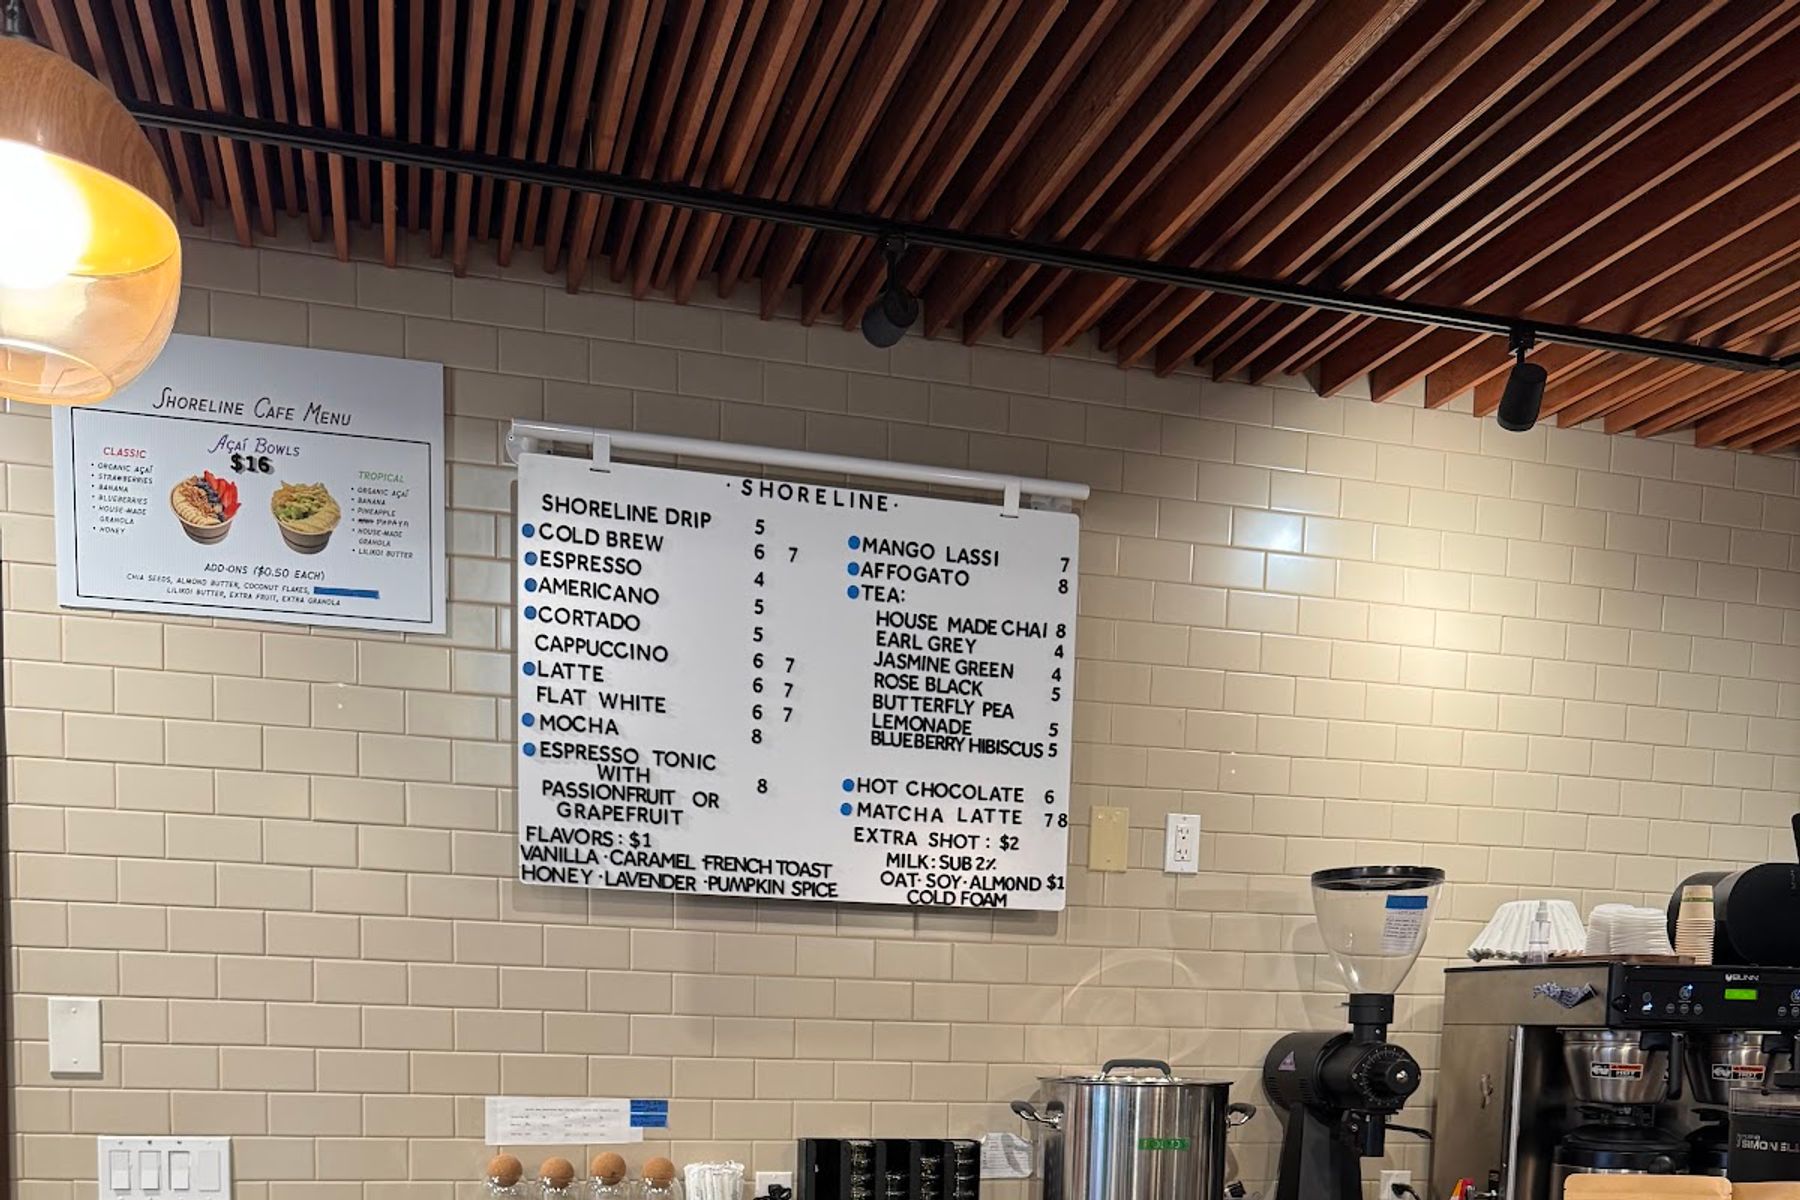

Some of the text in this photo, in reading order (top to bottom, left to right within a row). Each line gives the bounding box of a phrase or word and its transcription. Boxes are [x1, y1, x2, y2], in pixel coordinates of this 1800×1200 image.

[103, 447, 146, 458] CLASSIC
[231, 453, 272, 473] $16
[98, 462, 130, 471] ORGANIC
[98, 473, 152, 484] STRAWBERRIES
[359, 471, 404, 482] TROPICAL
[99, 484, 128, 492] BANANA
[99, 495, 148, 505] BLUEBERRIES
[357, 487, 388, 496] ORGANIC
[358, 497, 385, 505] BANANA
[740, 478, 888, 513] SHORELINE
[100, 516, 134, 524] GRANOLA
[357, 507, 395, 517] PINEAPPLE
[541, 493, 765, 536] SHORELINE DRIP 5
[359, 538, 391, 547] GRANOLA
[386, 550, 413, 558] BUTTER
[538, 522, 799, 563] COLD BREW 6 7
[862, 536, 1071, 573] MANGO LASSI 7
[204, 563, 248, 574] ADD-ONS
[295, 570, 326, 581] EACH)
[540, 549, 765, 588] ESPRESSO 4
[860, 561, 1069, 595] AFFOGATO 8
[177, 578, 207, 586] ALMOND
[243, 582, 278, 591] COCONUT
[538, 576, 765, 615] AMERICANO 5
[860, 583, 906, 604] TEA:
[229, 591, 253, 599] EXTRA
[282, 595, 304, 603] EXTRA
[308, 597, 341, 606] GRANOLA
[538, 605, 764, 643] CORTADO 5
[875, 609, 1067, 639] HOUSE MADE CHAI 8
[534, 634, 795, 674] CAPPUCCINO 6 7
[876, 629, 1065, 659] EARL GREY 4
[537, 659, 794, 698] LATTE 6 7
[873, 650, 1062, 683] JASMINE GREEN 4
[874, 671, 1061, 702] ROSE BLACK 5
[536, 685, 793, 723] FLAT WHITE 6 7
[872, 693, 1015, 720] BUTTERFLY PEA
[539, 714, 763, 745] MOCHA 8
[871, 712, 1059, 738] LEMONADE 5
[540, 740, 717, 771] ESPRESSO TONIC
[870, 729, 1058, 759] BLUEBERRY HIBISCUS 5
[596, 763, 768, 794] WITH 8
[857, 776, 1055, 805] HOT CHOCOLATE 6
[542, 779, 720, 809] PASSIONFRUIT OR
[556, 800, 684, 826] GRAPEFRUIT
[856, 801, 1068, 828] MATCHA LATTE 7 8
[629, 830, 652, 850] $1
[854, 826, 918, 846] EXTRA
[999, 833, 1020, 852] $2
[520, 844, 600, 865] VANILLA
[775, 859, 833, 879] TOAST
[886, 852, 997, 872] MILK: SUB 2%
[521, 863, 594, 885] HONEY
[790, 880, 839, 898] SPICE
[1046, 873, 1065, 892] $1
[907, 890, 1008, 908] COLD FOAM
